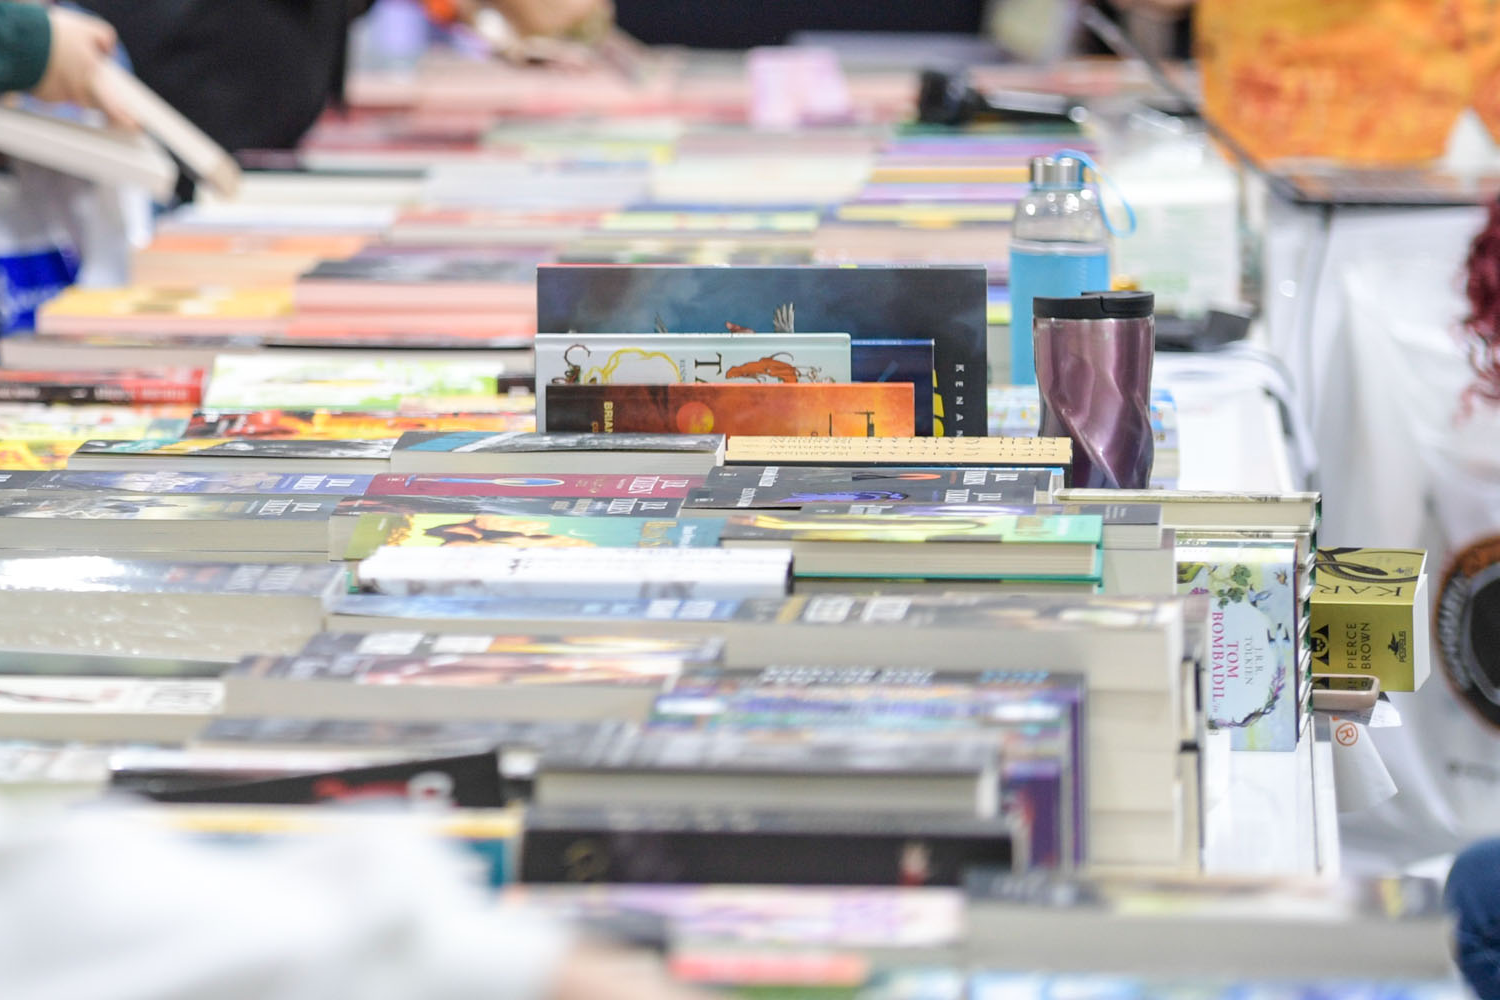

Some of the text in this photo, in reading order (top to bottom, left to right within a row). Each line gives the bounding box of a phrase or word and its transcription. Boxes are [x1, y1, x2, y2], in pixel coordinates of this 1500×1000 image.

[1315, 583, 1404, 598] KAR
[1226, 640, 1239, 679] TOM
[1243, 636, 1253, 686] TOLKIEN
[1346, 622, 1358, 670] PIERCE
[1360, 621, 1372, 670] BROWN
